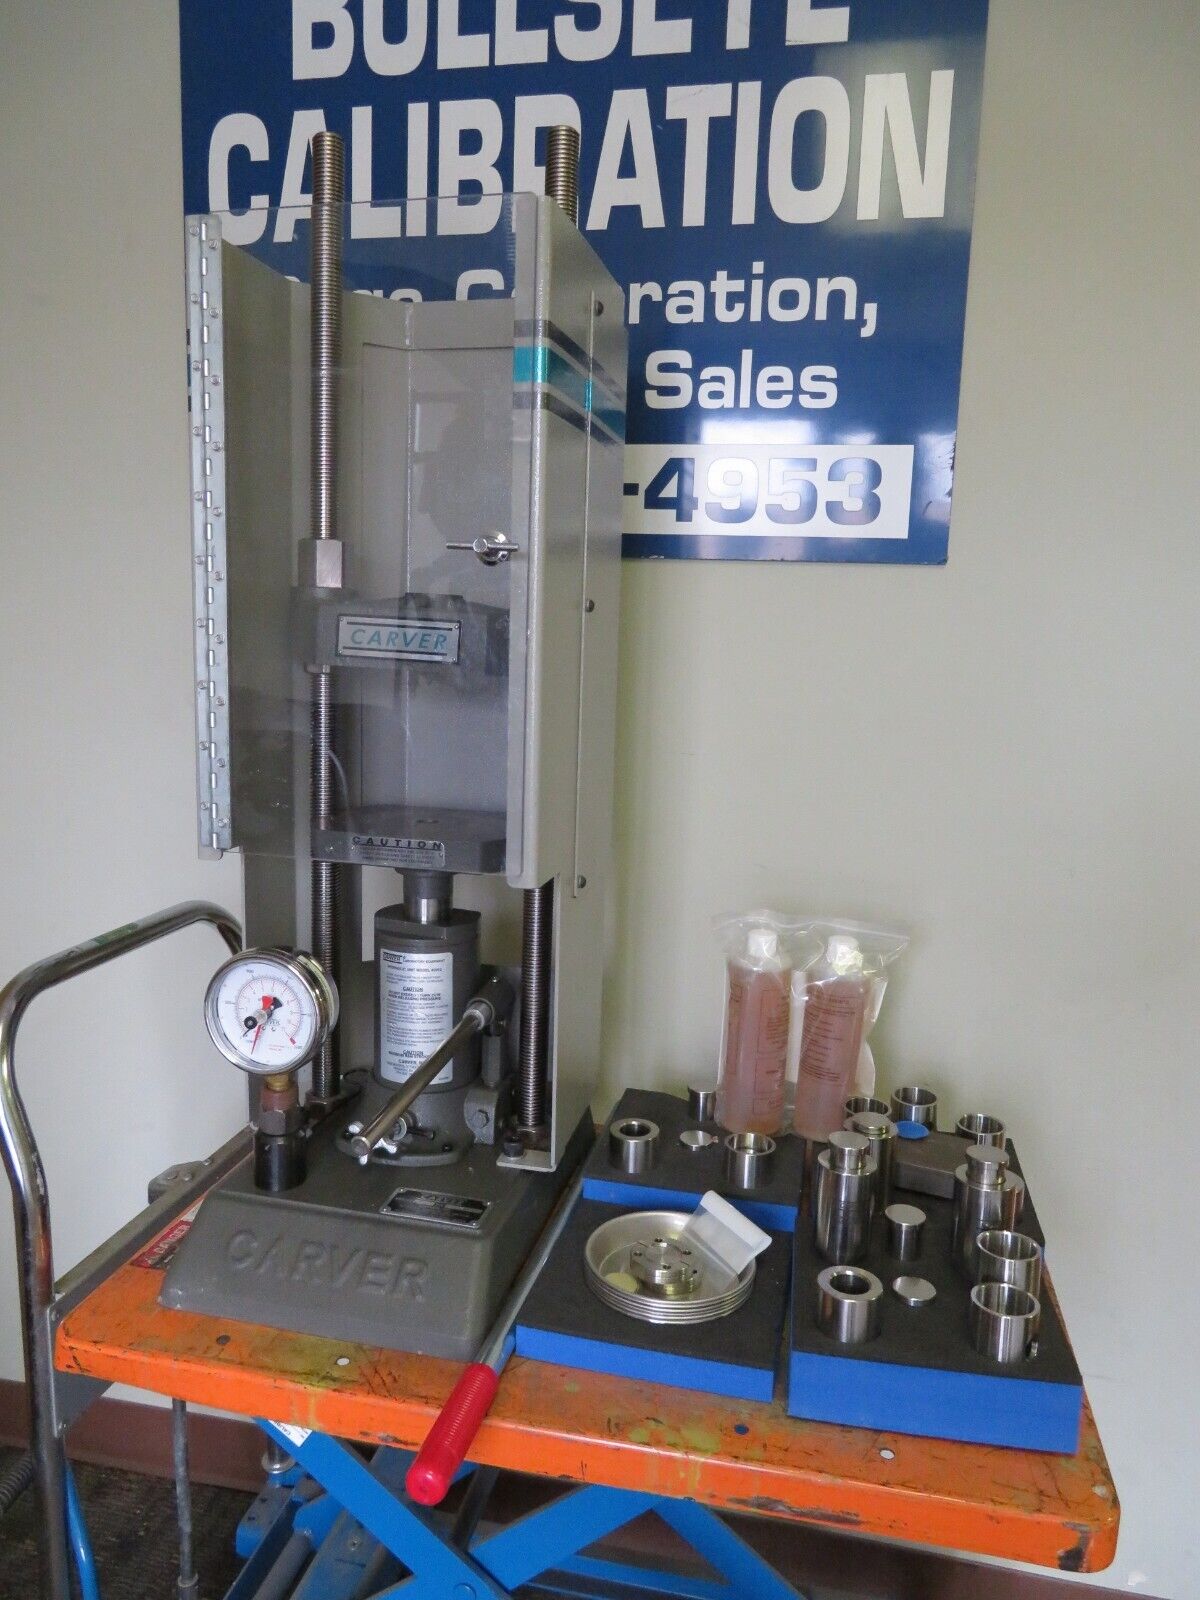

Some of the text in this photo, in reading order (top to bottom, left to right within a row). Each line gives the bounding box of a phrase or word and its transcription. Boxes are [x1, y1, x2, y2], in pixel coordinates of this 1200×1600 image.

[208, 70, 955, 247] CALIBRATION
[644, 349, 838, 410] Sales
[351, 628, 448, 651] CARVER
[352, 836, 442, 851] CAUTION
[226, 1229, 428, 1302] CARVER
